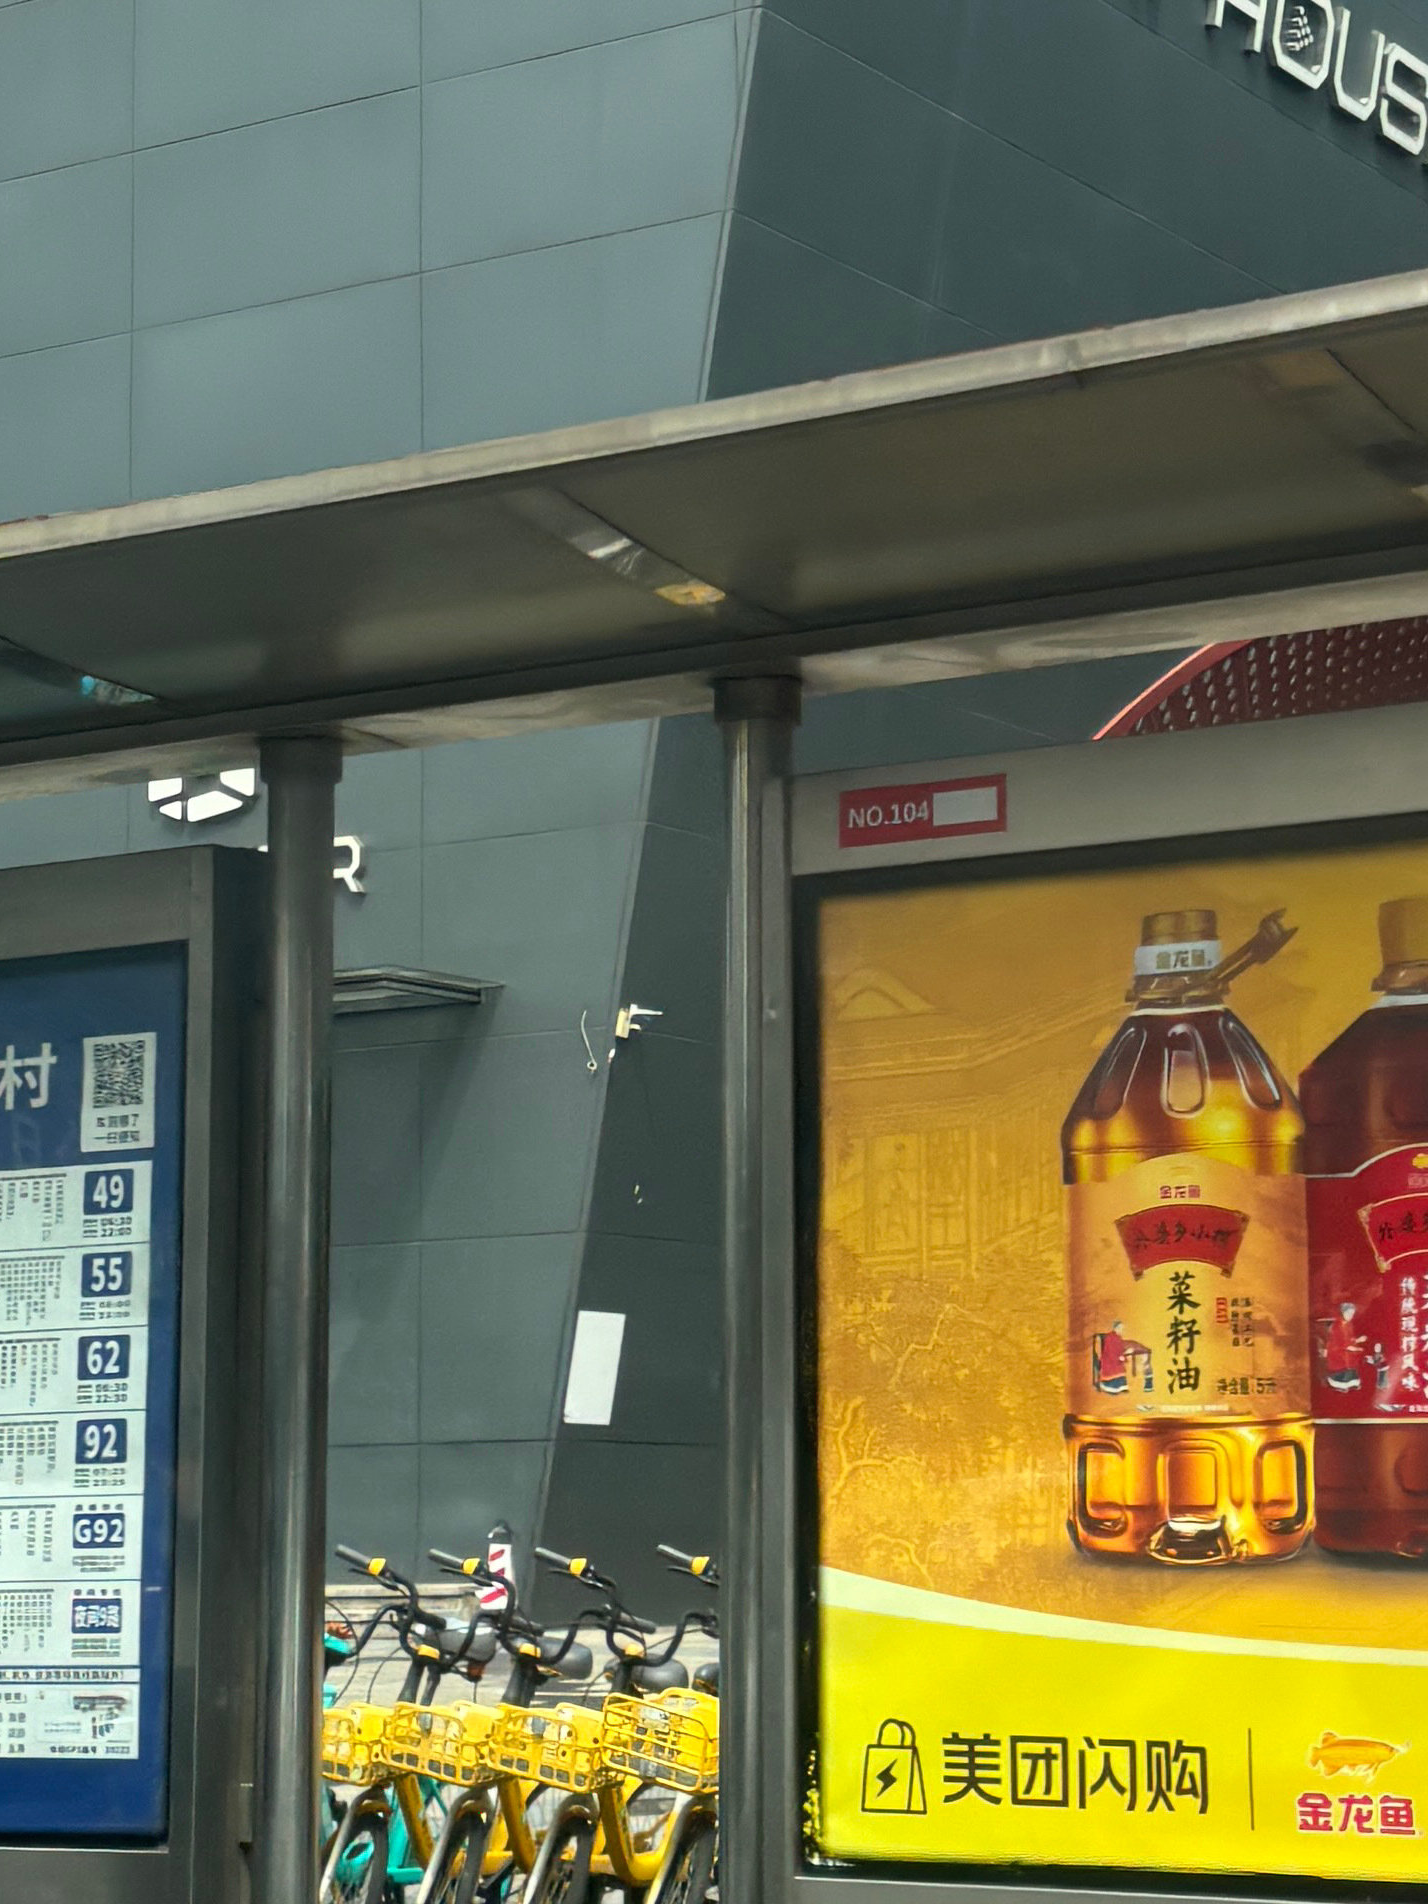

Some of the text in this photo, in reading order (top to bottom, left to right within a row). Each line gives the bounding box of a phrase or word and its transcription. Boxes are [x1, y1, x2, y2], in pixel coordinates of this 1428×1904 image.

[847, 800, 929, 828] NO.104
[93, 1175, 124, 1209] 49
[90, 1257, 122, 1292] 55
[1166, 1271, 1201, 1394] 菜籽油
[87, 1340, 120, 1375] 62
[84, 1424, 118, 1459] 92
[75, 1519, 123, 1544] G92
[942, 1731, 1210, 1815] 美团闪购
[1297, 1792, 1416, 1834] 金龙鱼
